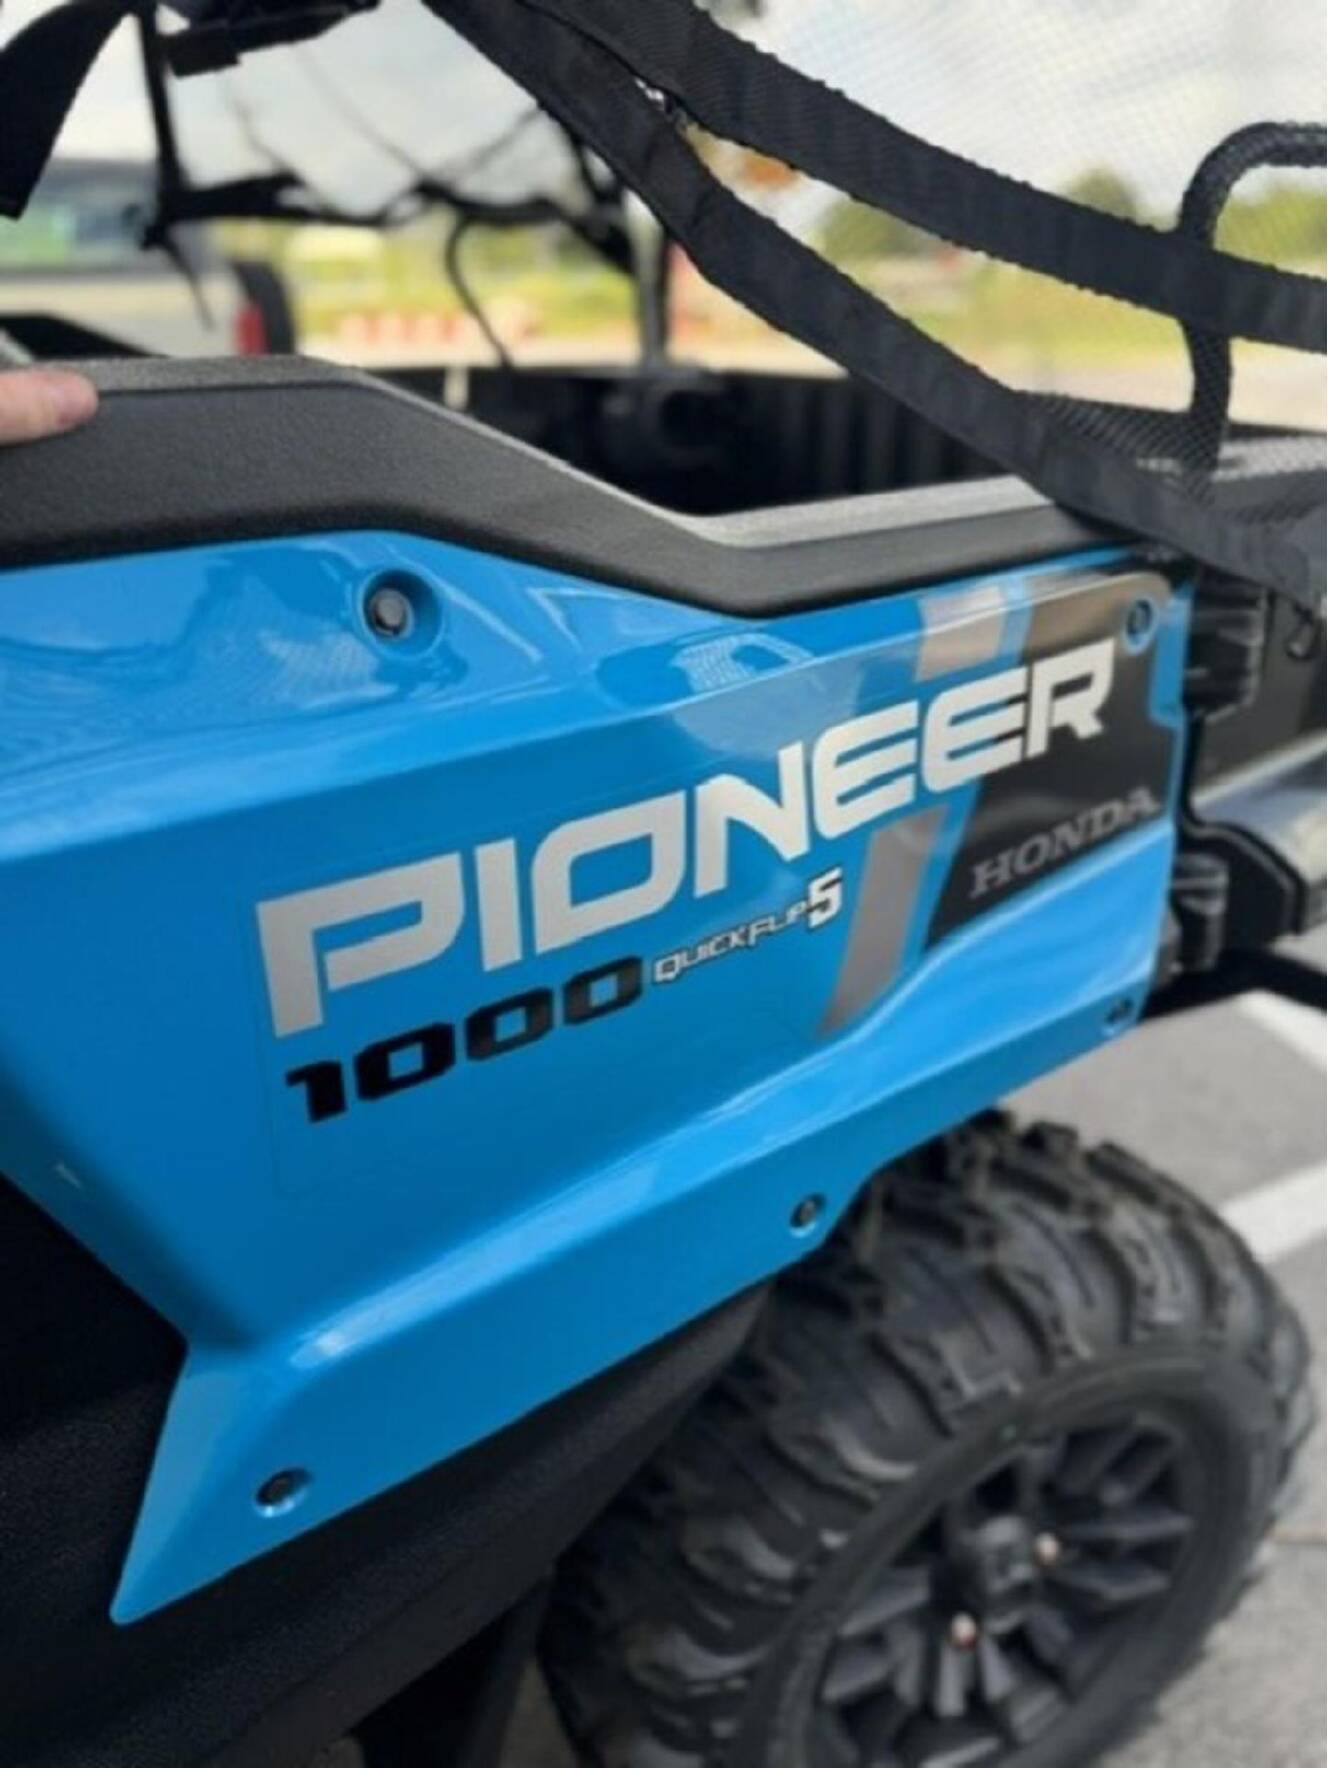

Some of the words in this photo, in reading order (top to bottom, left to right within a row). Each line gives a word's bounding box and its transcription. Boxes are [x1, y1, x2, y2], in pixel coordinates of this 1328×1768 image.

[256, 638, 1115, 1039] PIONEER
[970, 785, 1161, 899] HONDA
[285, 955, 643, 1123] 1000
